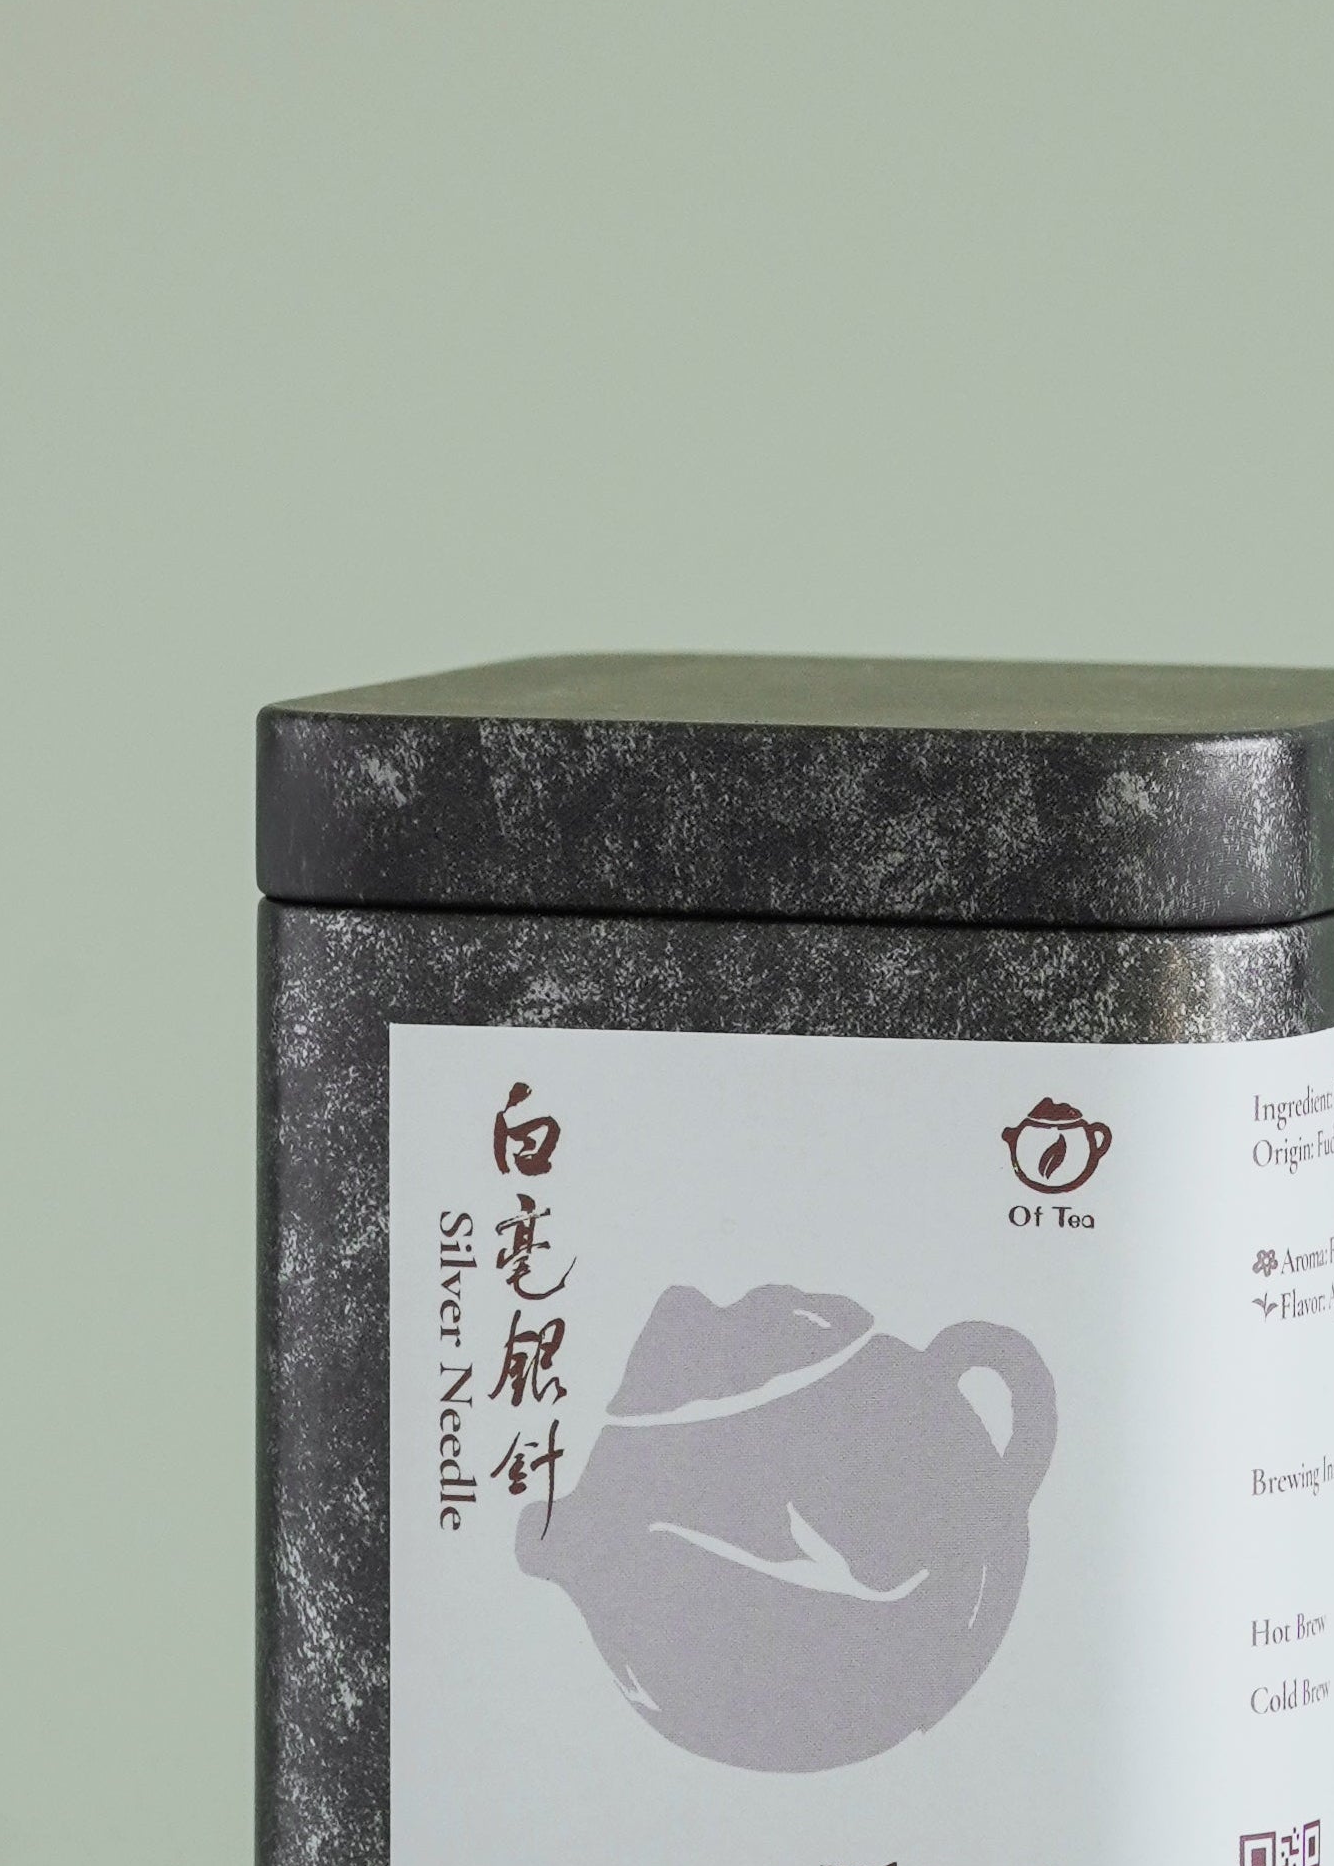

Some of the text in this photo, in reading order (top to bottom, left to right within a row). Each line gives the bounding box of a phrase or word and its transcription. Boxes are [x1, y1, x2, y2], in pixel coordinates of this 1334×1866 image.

[1253, 1086, 1334, 1131] Ingredient:
[1252, 1137, 1315, 1175] Origin:
[1008, 1205, 1096, 1230] Of Tea
[1280, 1247, 1328, 1276] Aroma:
[1280, 1287, 1327, 1322] Flavor:
[437, 1209, 478, 1533] Silver Needle
[1251, 1462, 1322, 1497] Brewing
[1250, 1619, 1292, 1647] Hot
[1296, 1611, 1328, 1640] Brew
[1250, 1680, 1299, 1715] Cold
[1302, 1677, 1332, 1707] Brew
